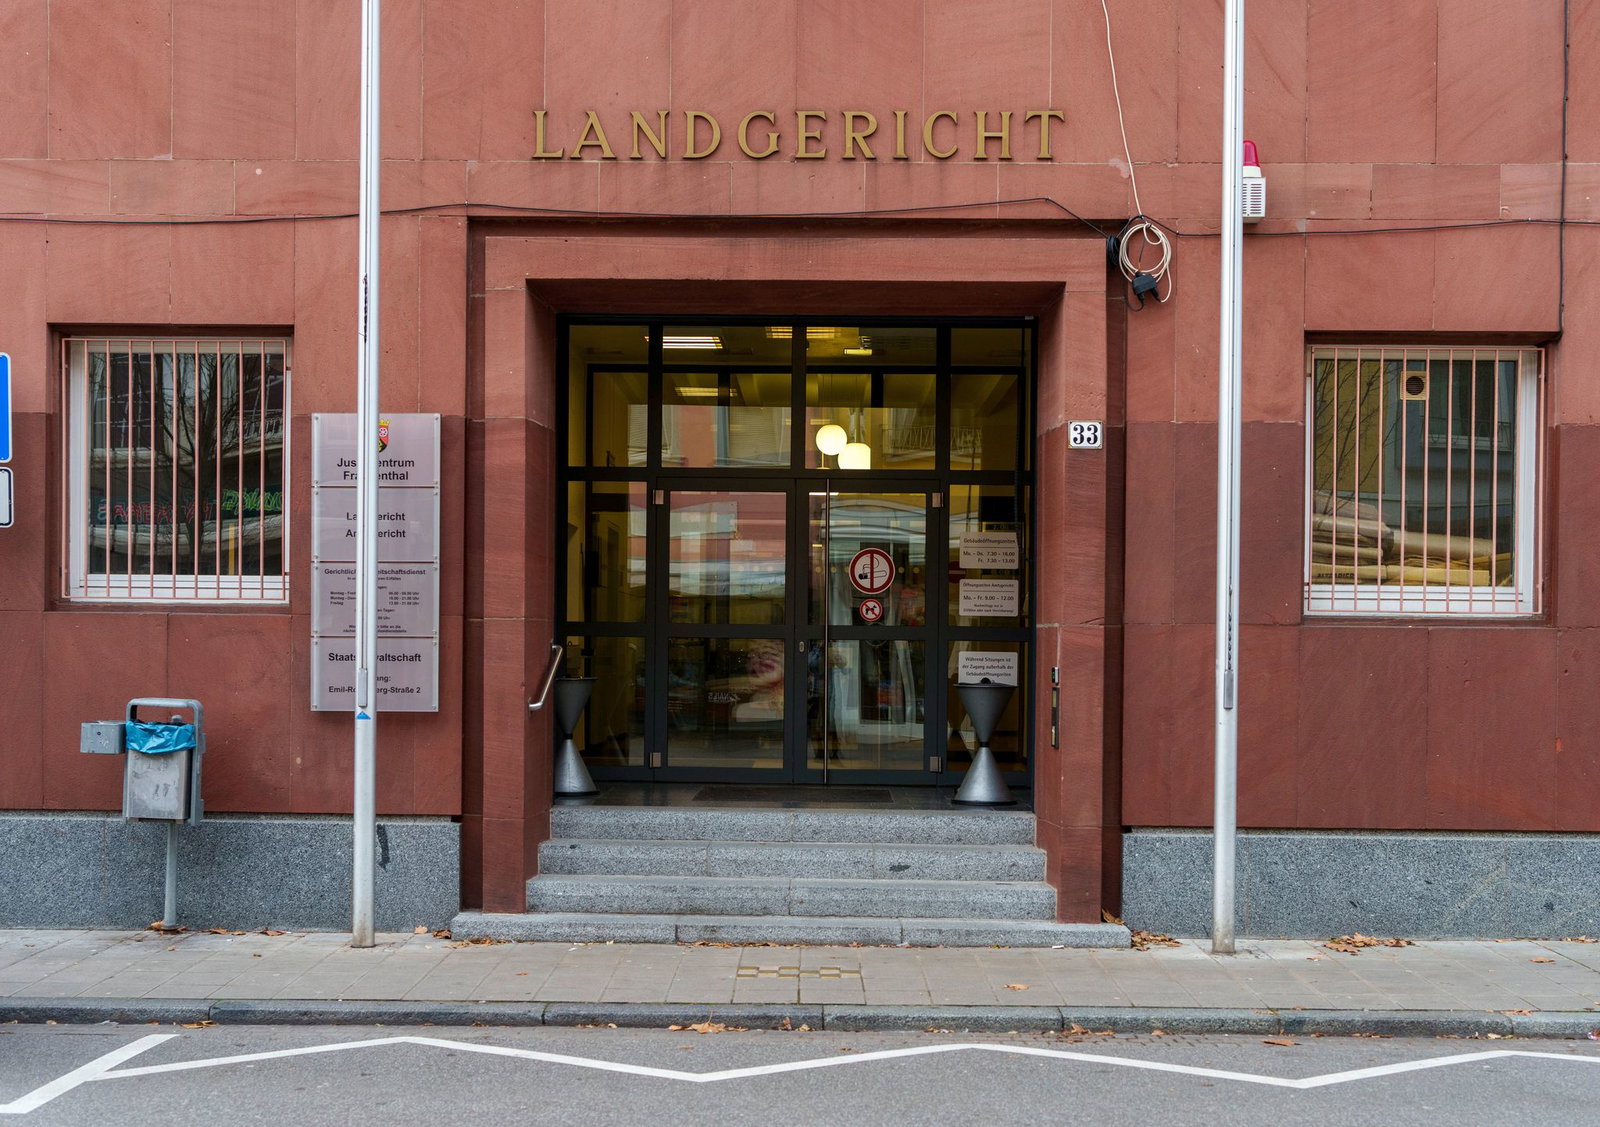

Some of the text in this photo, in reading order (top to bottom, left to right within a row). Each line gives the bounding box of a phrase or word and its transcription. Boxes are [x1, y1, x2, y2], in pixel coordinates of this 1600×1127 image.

[531, 110, 1066, 159] LANDGERICHT
[1073, 424, 1098, 445] 33
[337, 457, 415, 468] Jusentrum
[346, 512, 406, 521] Laericht
[346, 528, 406, 538] Aericht
